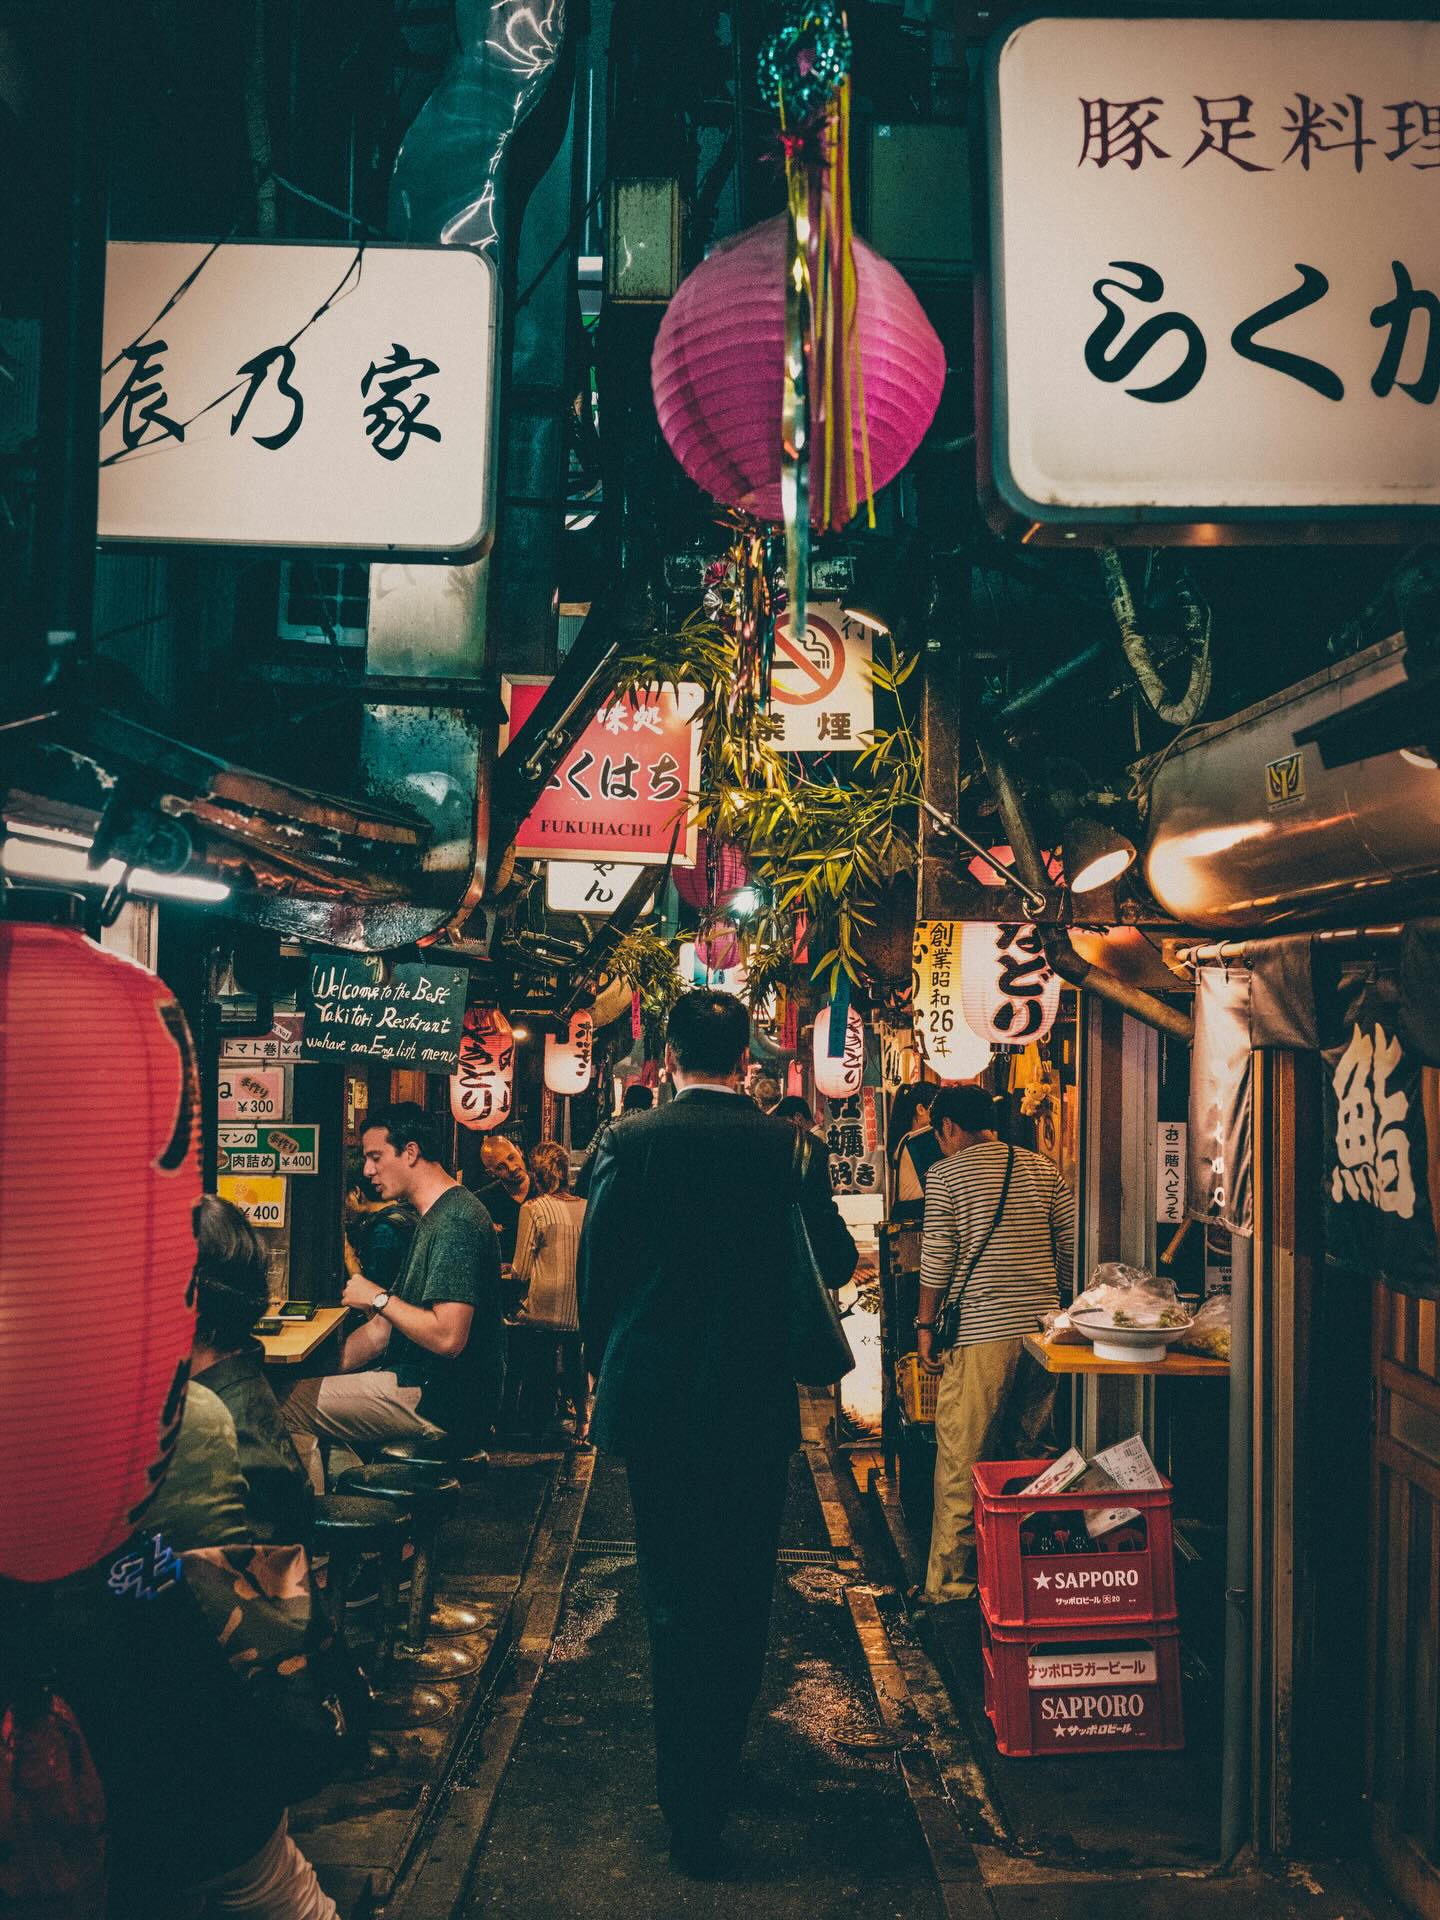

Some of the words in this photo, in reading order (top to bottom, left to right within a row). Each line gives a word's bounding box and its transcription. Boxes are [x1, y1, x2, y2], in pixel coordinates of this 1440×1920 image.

[1077, 92, 1440, 173] 豚足料理
[545, 749, 682, 801] くはち
[540, 818, 652, 837] FUKUHACHI
[311, 965, 380, 1000] Welcome
[380, 985, 394, 999] to
[393, 982, 411, 1000] the
[411, 976, 450, 1005] Best
[929, 922, 955, 1058] 創業昭和26年
[314, 1002, 374, 1027] Yakitori
[224, 1041, 277, 1056] トマト巻
[350, 1042, 368, 1054] an
[368, 1035, 416, 1060] English
[237, 1100, 274, 1113] ¥300
[219, 1133, 256, 1144] マンの
[232, 1155, 274, 1168] 肉詰め
[281, 1155, 312, 1167] ¥400
[1054, 1569, 1139, 1590] SAPPORO
[1055, 1596, 1101, 1606] サッポロビール
[1028, 1660, 1146, 1679] サッポロラガービール
[1041, 1694, 1145, 1720] SAPPORO
[1067, 1723, 1132, 1737] サッポロビール
